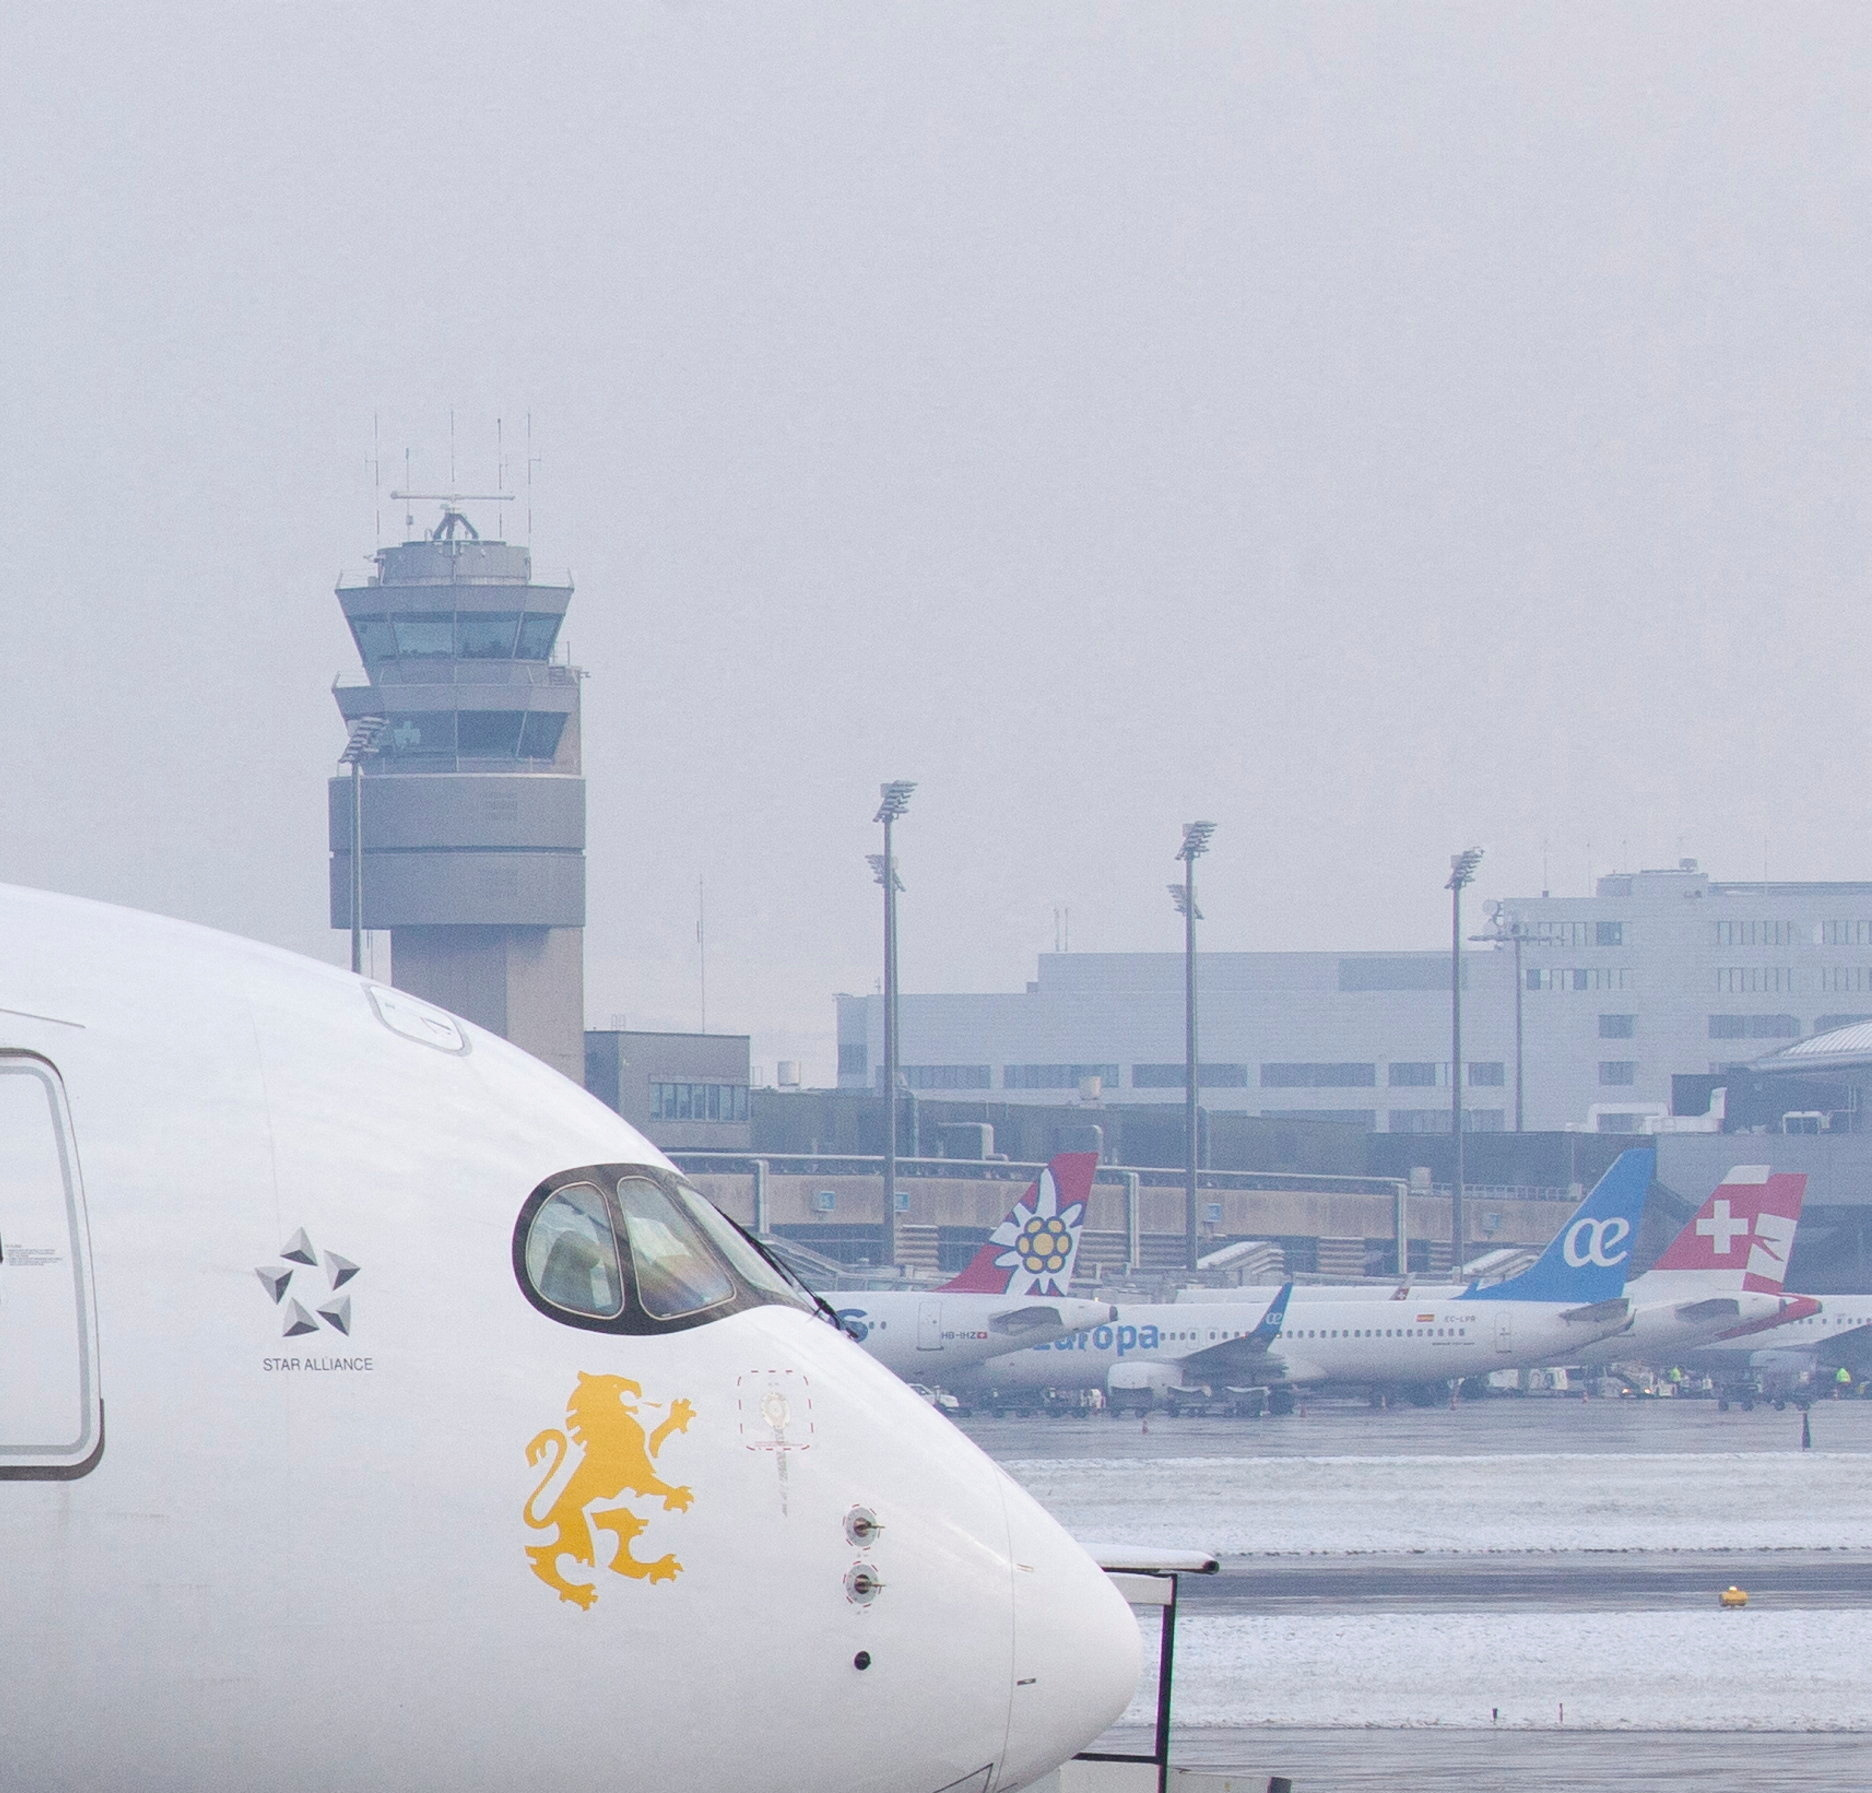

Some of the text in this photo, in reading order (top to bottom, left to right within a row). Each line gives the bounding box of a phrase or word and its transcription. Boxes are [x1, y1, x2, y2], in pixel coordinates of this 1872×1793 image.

[1030, 1322, 1159, 1357] uropa
[262, 1357, 374, 1371] STAR ALLIANCE
